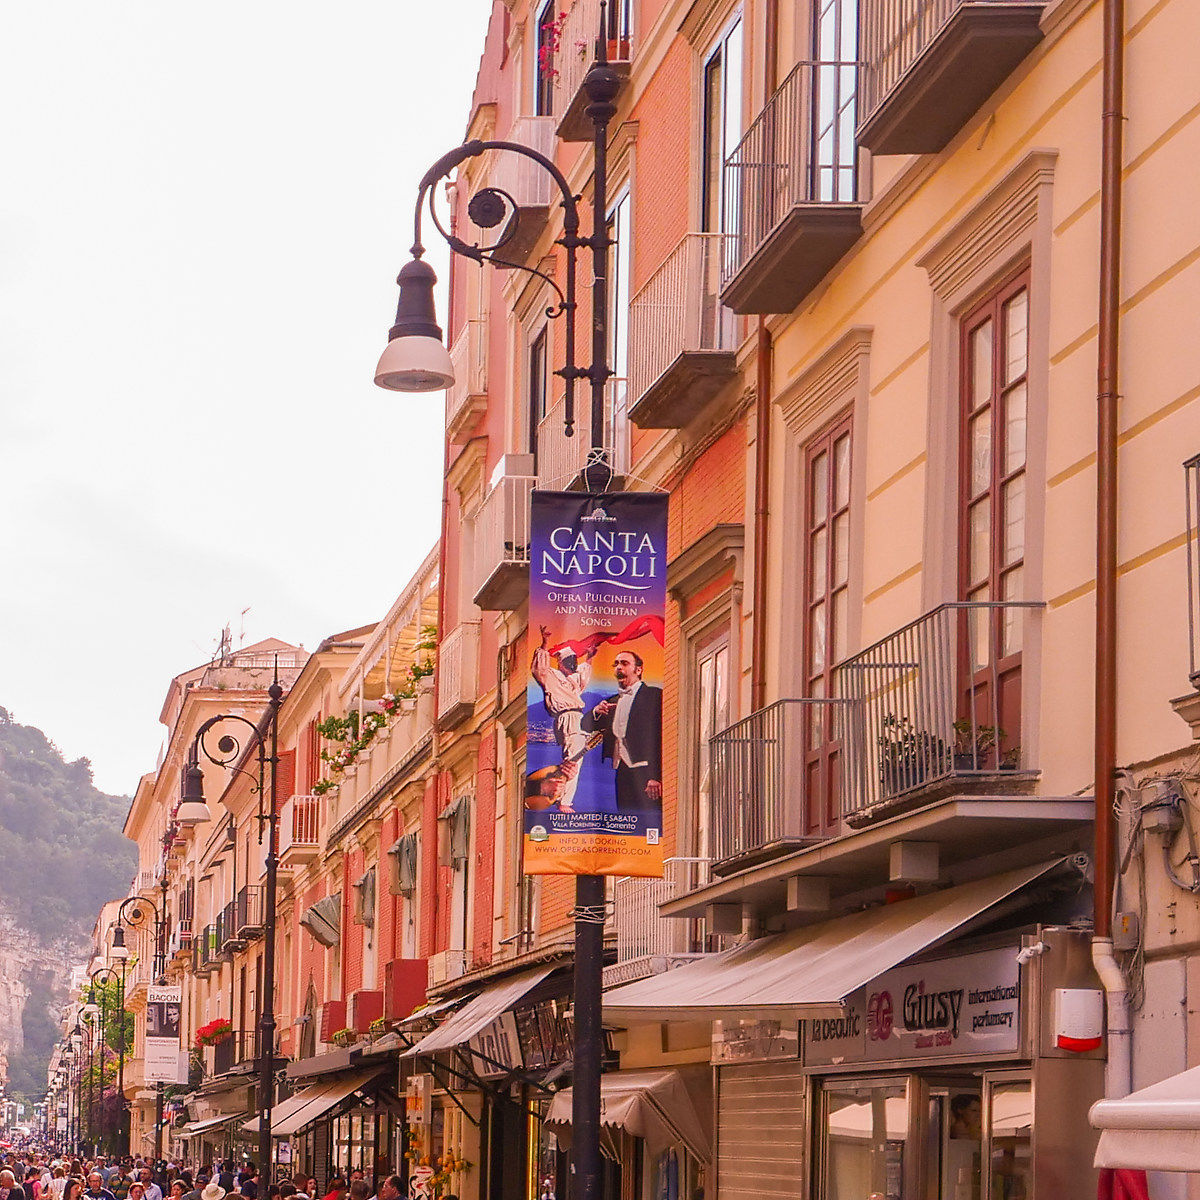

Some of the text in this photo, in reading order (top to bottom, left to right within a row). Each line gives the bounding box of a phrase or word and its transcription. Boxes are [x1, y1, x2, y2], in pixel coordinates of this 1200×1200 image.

[550, 527, 657, 554] CANTA
[540, 550, 657, 577] NAPOLI
[149, 994, 179, 1002] BACON
[968, 982, 1019, 1005] international
[903, 980, 964, 1039] Giusy
[972, 1010, 1014, 1033] perfumery
